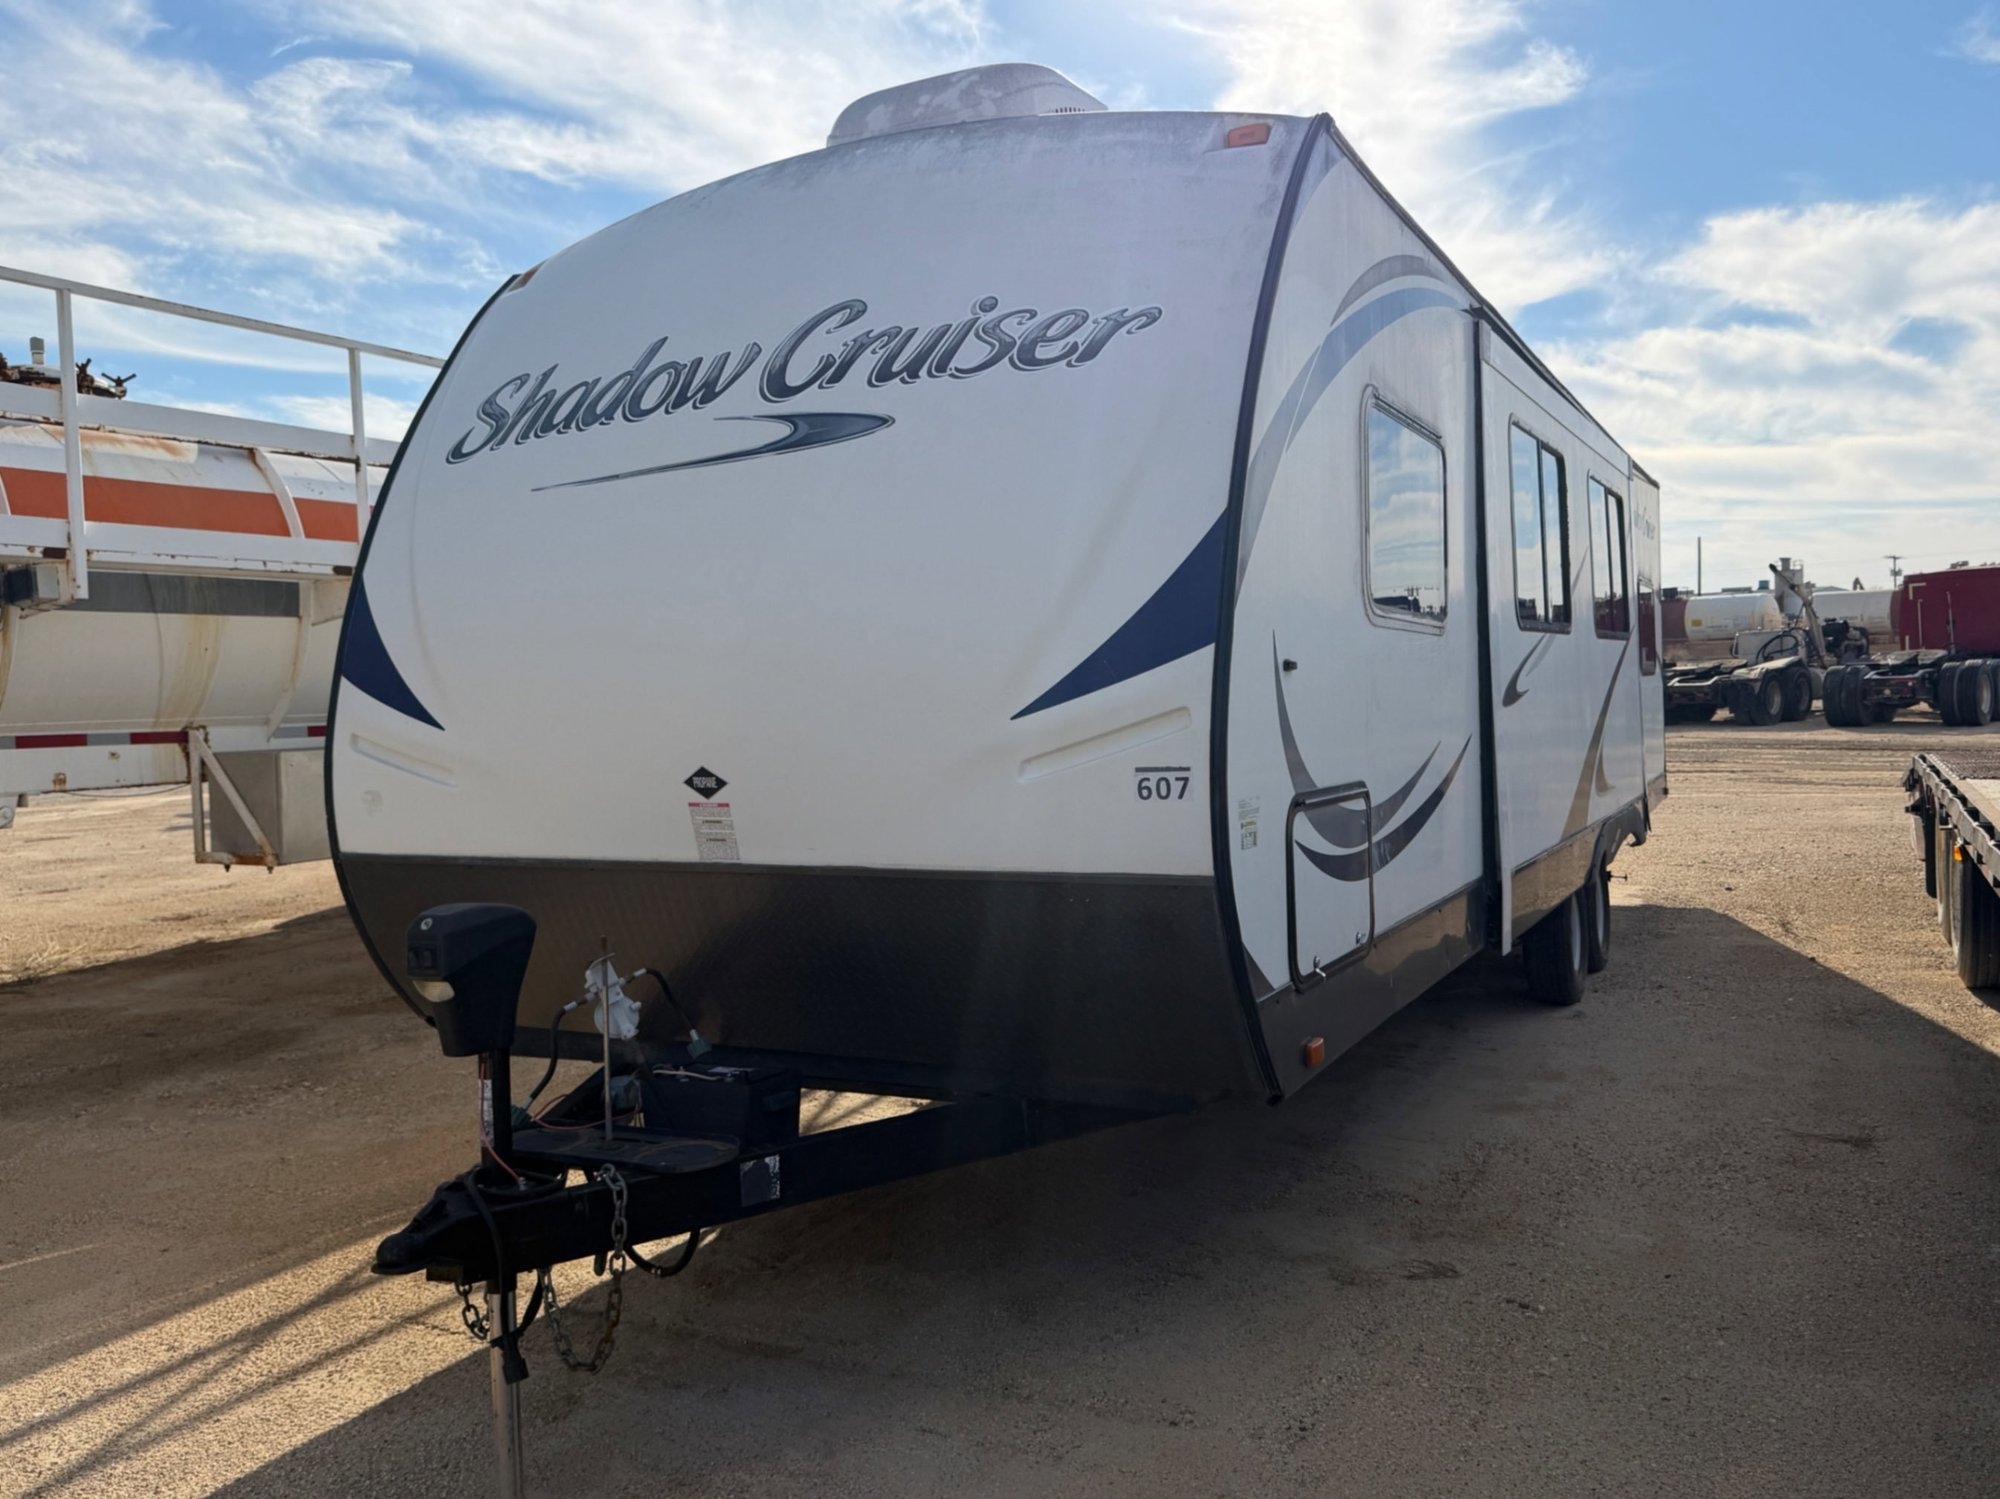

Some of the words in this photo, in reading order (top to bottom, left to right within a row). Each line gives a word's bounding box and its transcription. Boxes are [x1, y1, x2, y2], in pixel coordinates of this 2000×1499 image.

[446, 335, 762, 464] Shadow
[759, 296, 1162, 404] Cruiser
[1137, 776, 1190, 800] 607
